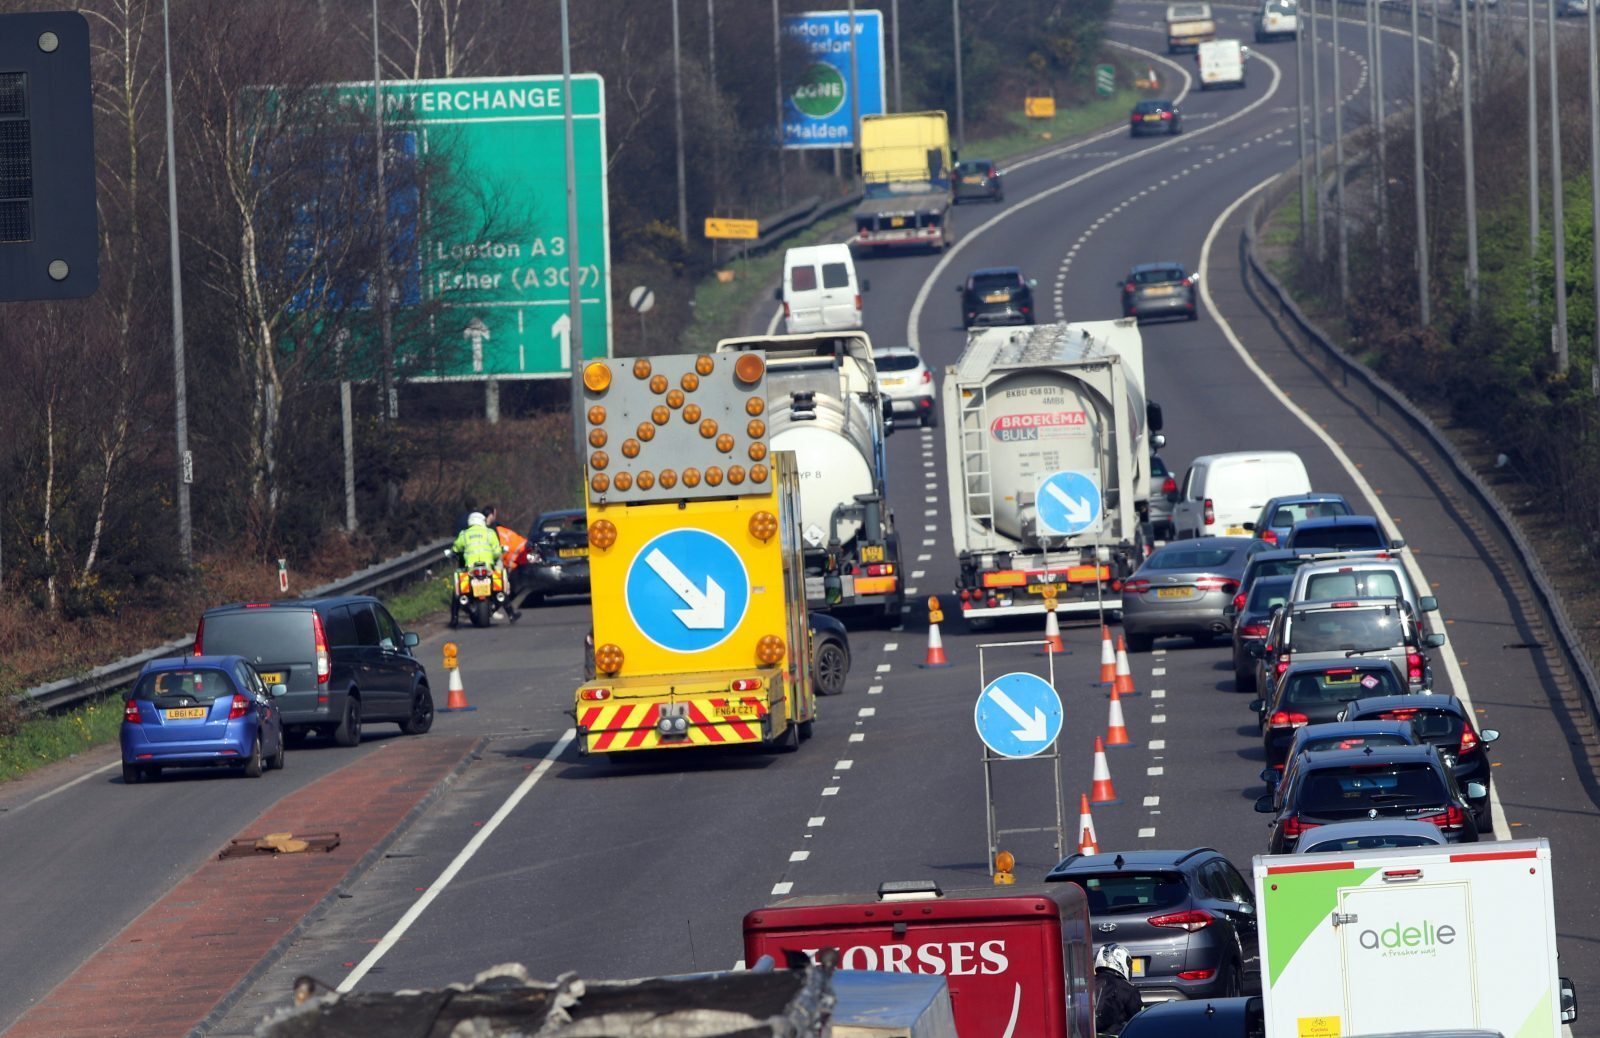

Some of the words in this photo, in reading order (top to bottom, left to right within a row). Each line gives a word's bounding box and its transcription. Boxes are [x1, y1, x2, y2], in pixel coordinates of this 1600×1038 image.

[834, 20, 864, 35] low
[795, 82, 841, 98] ZONE
[786, 122, 849, 138] Malden
[437, 240, 521, 260] London
[438, 270, 503, 292] Esher
[1001, 412, 1084, 428] BROEKEMA
[1002, 428, 1036, 441] BULK
[188, 708, 204, 717] KZJ
[715, 707, 736, 715] FN64
[737, 706, 753, 714] CZT
[1359, 920, 1457, 950] adelie
[1420, 947, 1436, 957] way
